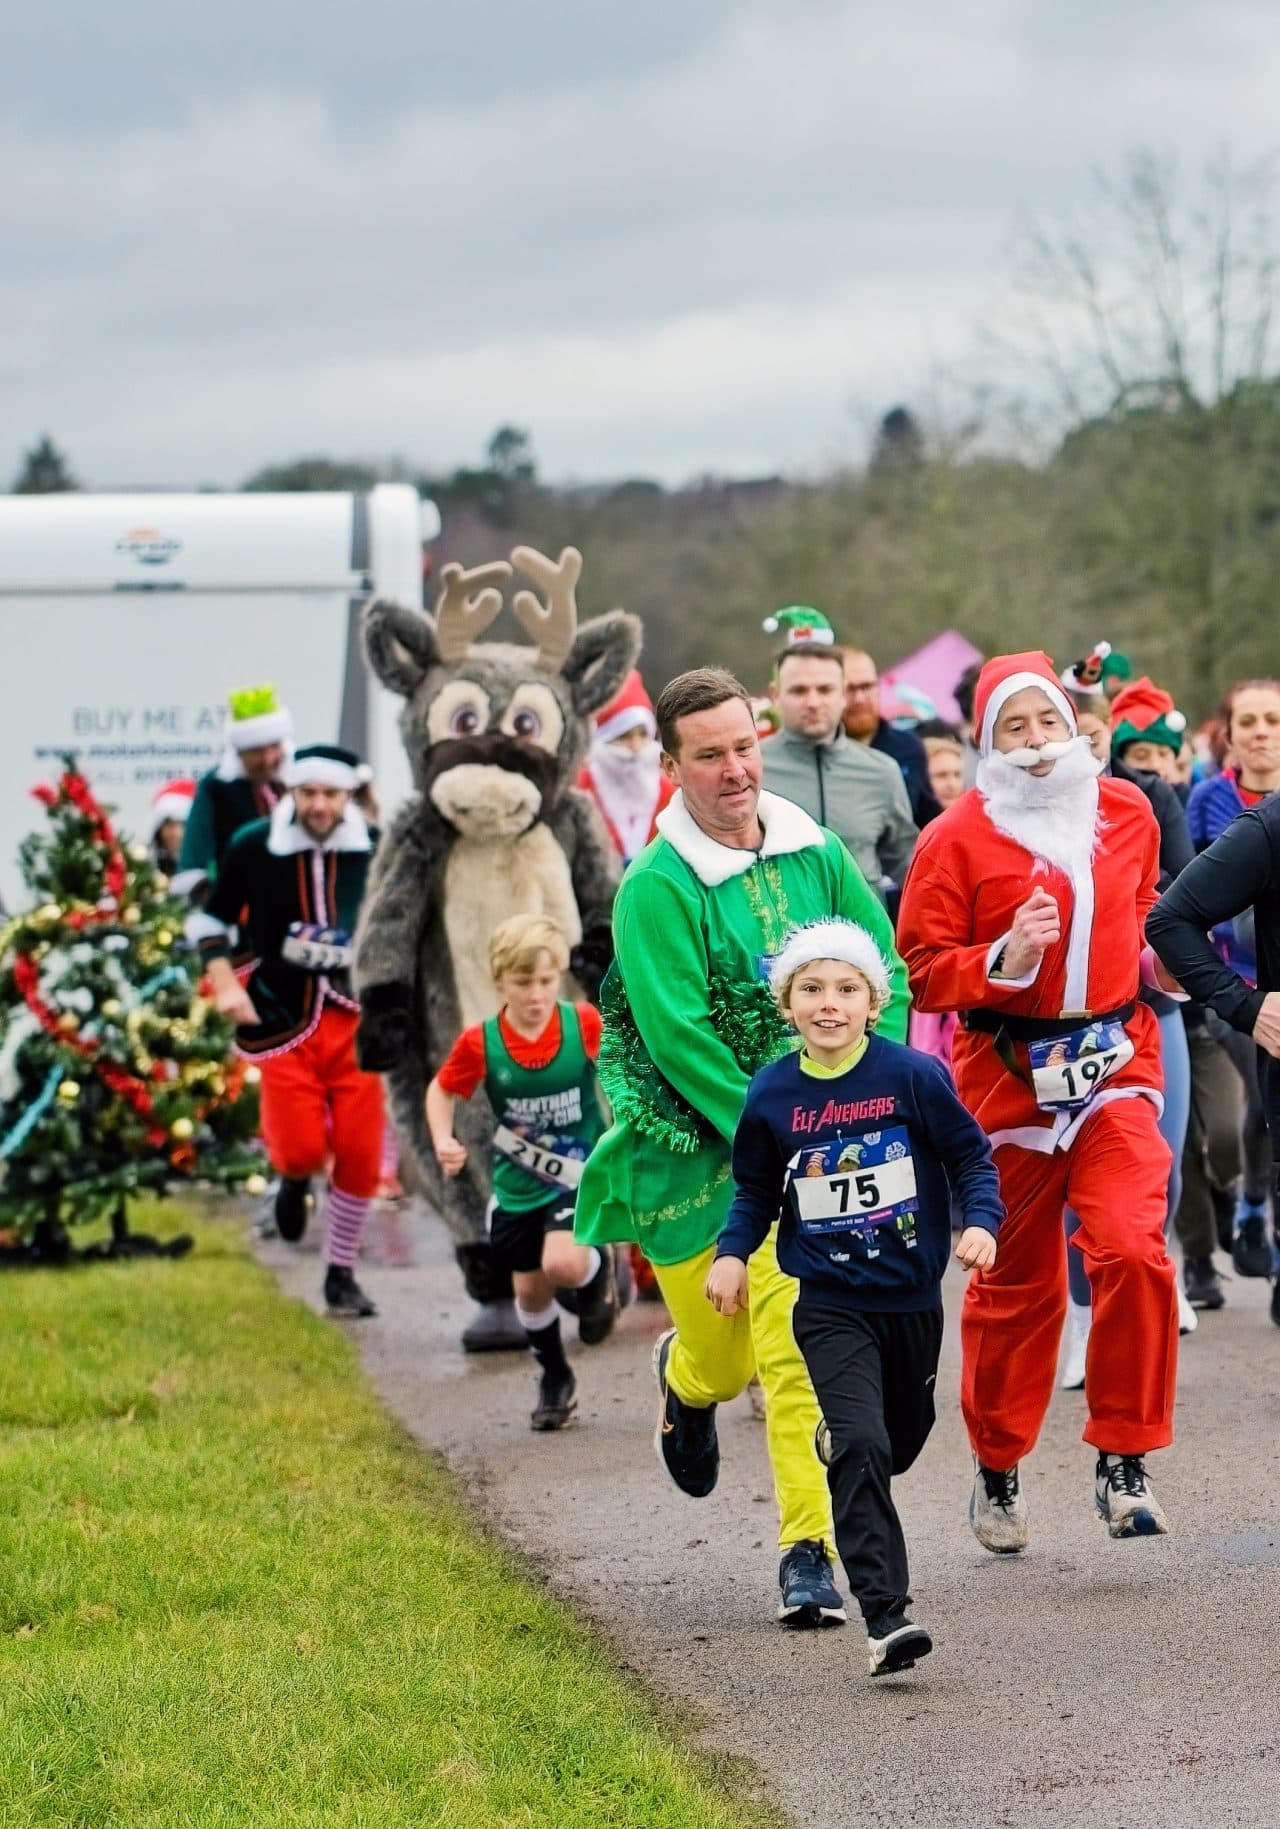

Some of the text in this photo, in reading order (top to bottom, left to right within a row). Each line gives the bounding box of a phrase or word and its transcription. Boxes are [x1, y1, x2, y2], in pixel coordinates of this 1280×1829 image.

[72, 706, 133, 736] BUY
[143, 704, 185, 734] ME
[1062, 1053, 1118, 1097] 197
[792, 1096, 895, 1133] ELF AVENGERS
[511, 1140, 563, 1177] 210
[830, 1173, 880, 1213] 75
